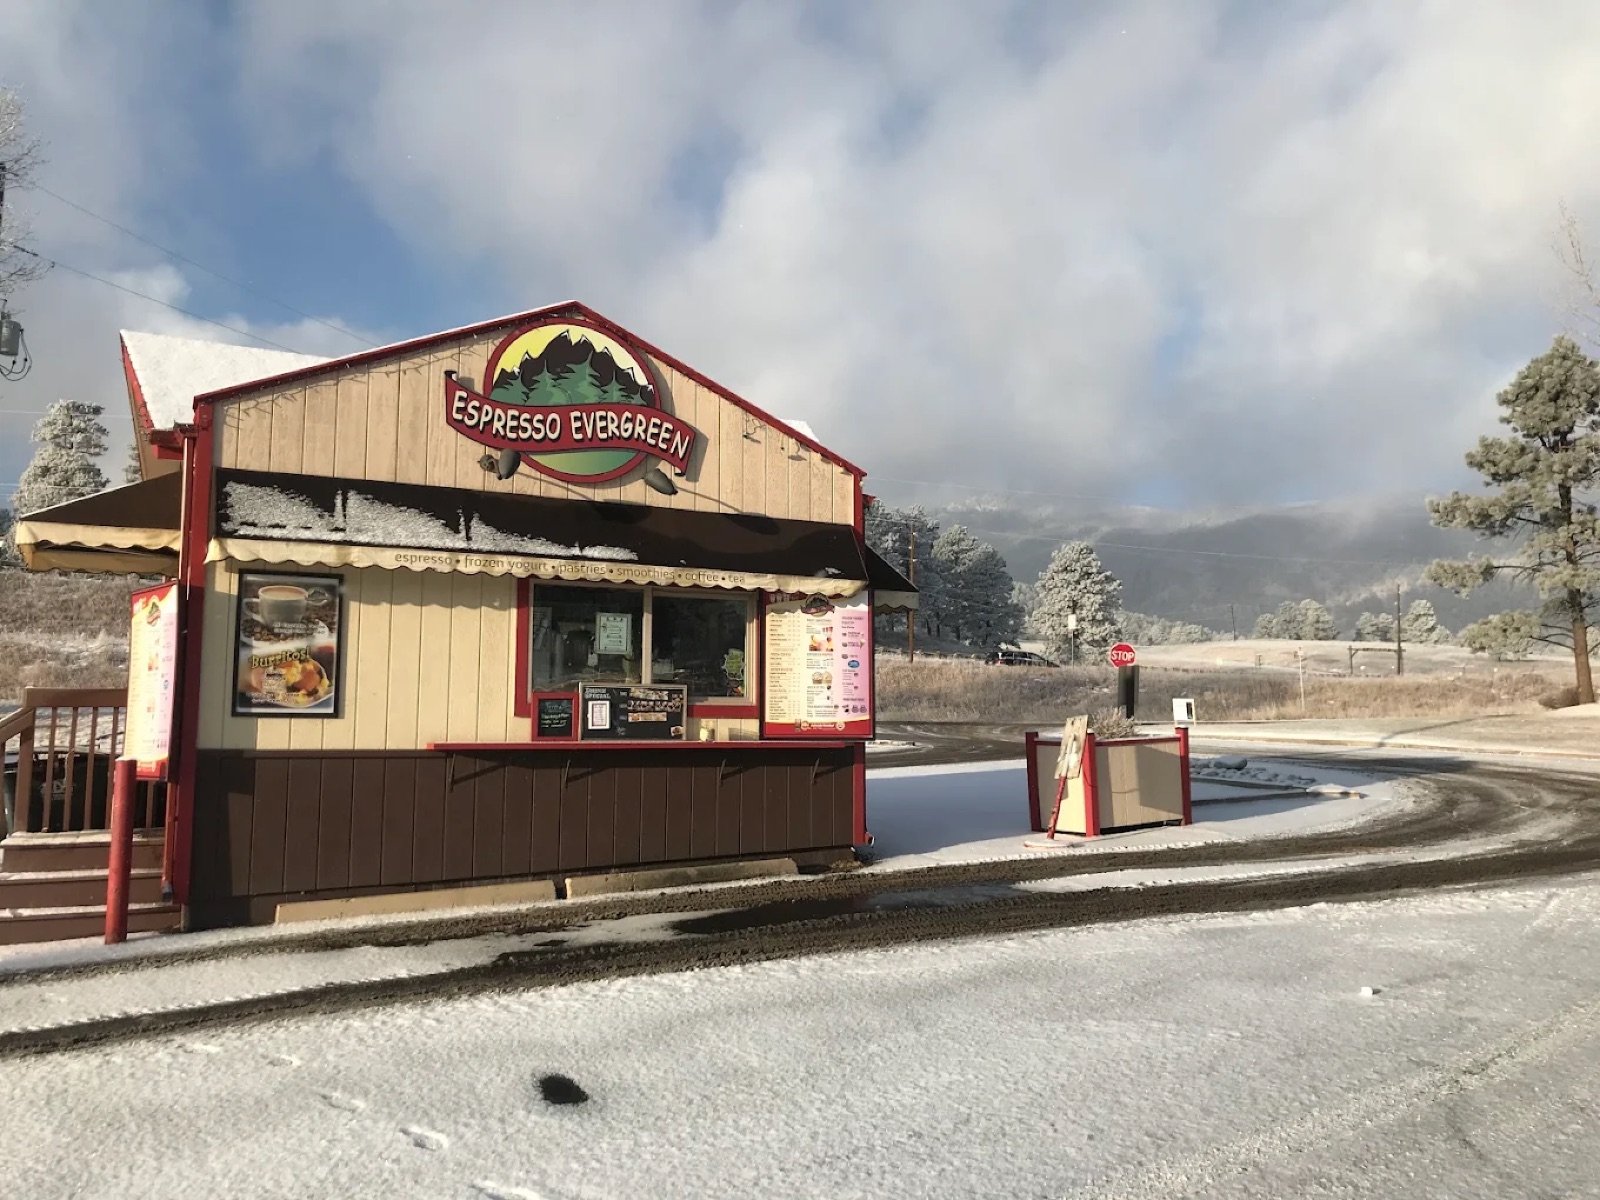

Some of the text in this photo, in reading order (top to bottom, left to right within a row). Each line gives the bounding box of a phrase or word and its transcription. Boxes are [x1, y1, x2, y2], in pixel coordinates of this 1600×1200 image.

[452, 390, 690, 460] ESPRESSO EVERGREEN
[394, 553, 745, 584] espresso frozen yogurt pastries smoothies coffee tea
[1111, 650, 1135, 661] STOP
